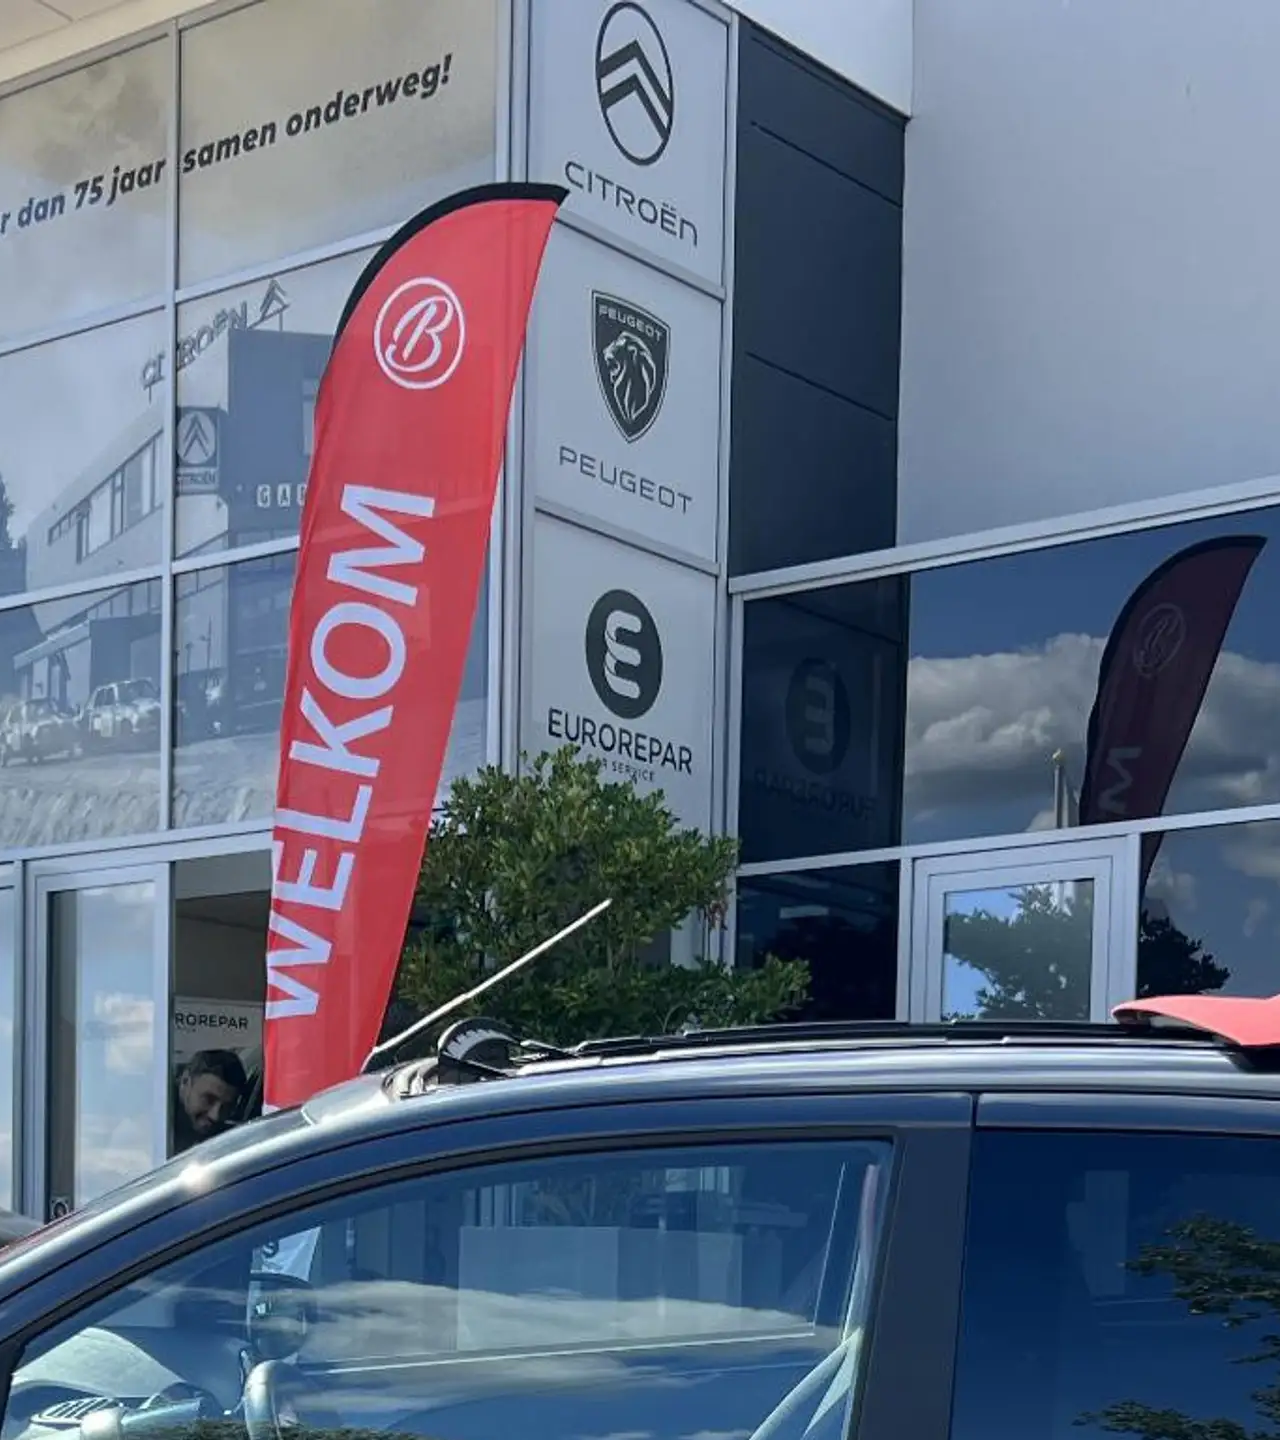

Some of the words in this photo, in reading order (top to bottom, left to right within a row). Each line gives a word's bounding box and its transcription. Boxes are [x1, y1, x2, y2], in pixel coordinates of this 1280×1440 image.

[17, 197, 66, 228] dan
[74, 175, 104, 210] 75
[105, 157, 167, 206] jaar
[181, 121, 277, 174] samen
[285, 52, 453, 136] onderweg!
[598, 303, 663, 342] PEUGEOT
[559, 445, 693, 515] PEUGEOT
[265, 483, 436, 1021] WELKOM
[547, 706, 693, 776] EUROREPAR
[174, 1012, 250, 1031] ROREPAR
